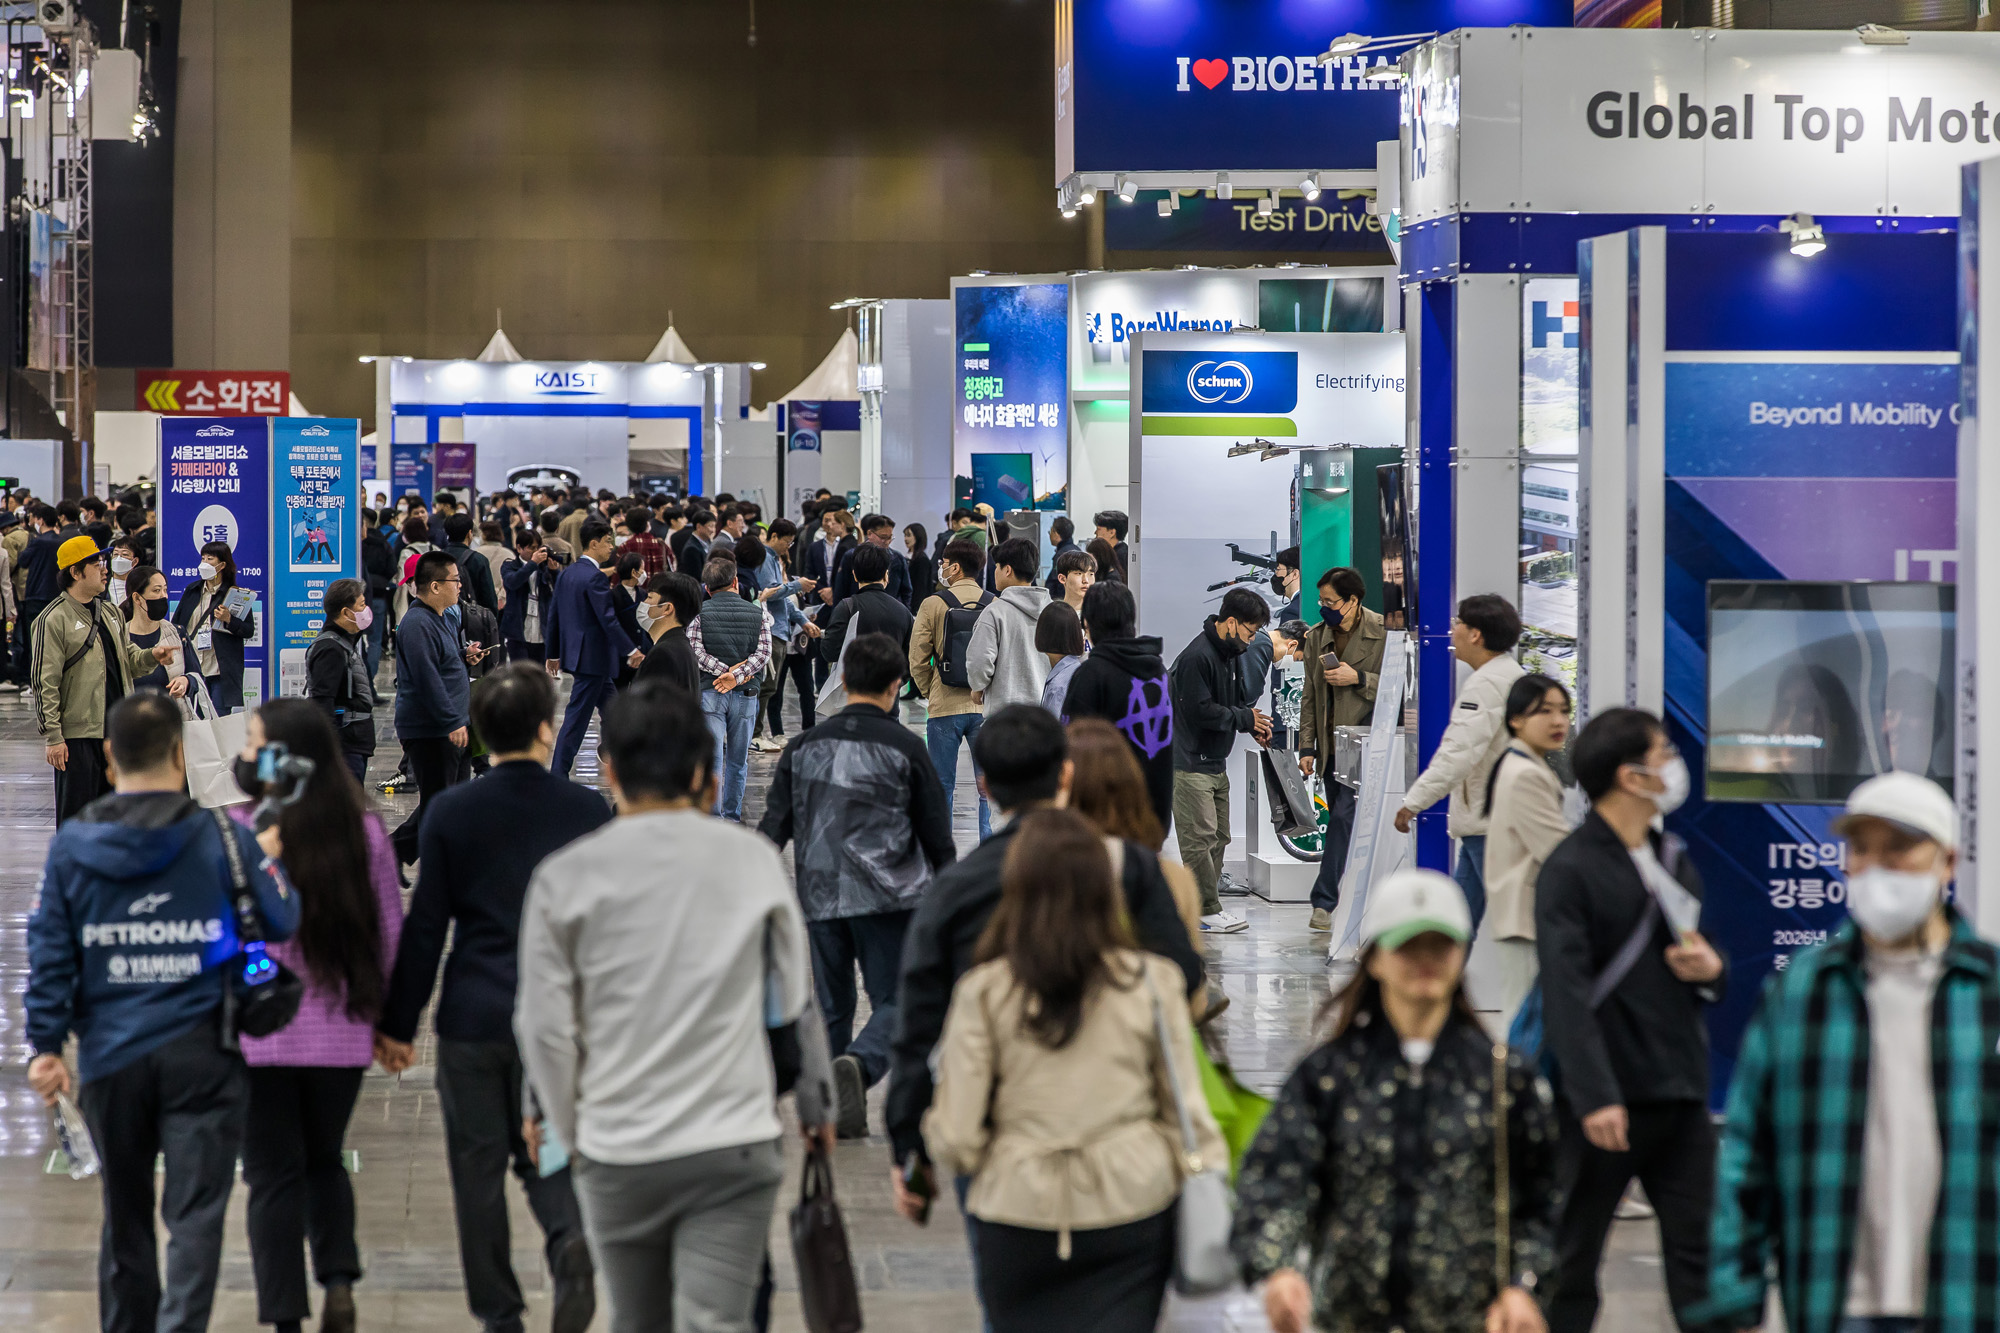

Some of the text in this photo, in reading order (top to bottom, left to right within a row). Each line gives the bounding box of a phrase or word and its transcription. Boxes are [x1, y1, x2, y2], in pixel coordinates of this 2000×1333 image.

[1177, 55, 1401, 92] I BIOETHA
[1587, 91, 1754, 140] Global
[1774, 94, 1864, 154] Top
[1233, 206, 1297, 233] Test
[536, 372, 599, 387] KAIST
[964, 376, 1004, 400] 청정하고
[1316, 373, 1405, 393] Electrifying
[185, 379, 282, 414] 소화전
[964, 403, 1059, 428] 에너지 효율적인 세상
[1749, 401, 1843, 428] Beyond
[1850, 401, 1943, 429] Mobility
[171, 445, 248, 460] 서울모빌리티쇼
[171, 462, 239, 477] 카페테리아 &
[290, 465, 341, 479] 틱톡 포토존에서
[171, 478, 240, 494] 시승행사 안내
[299, 480, 330, 494] 사진 찍고
[285, 495, 345, 508] 인증하고 선물받자!
[171, 568, 184, 577] 시승
[185, 568, 198, 577] 운영
[242, 567, 261, 577] 17:00
[1768, 842, 1846, 871] ITS의
[82, 918, 223, 947] PETRONAS
